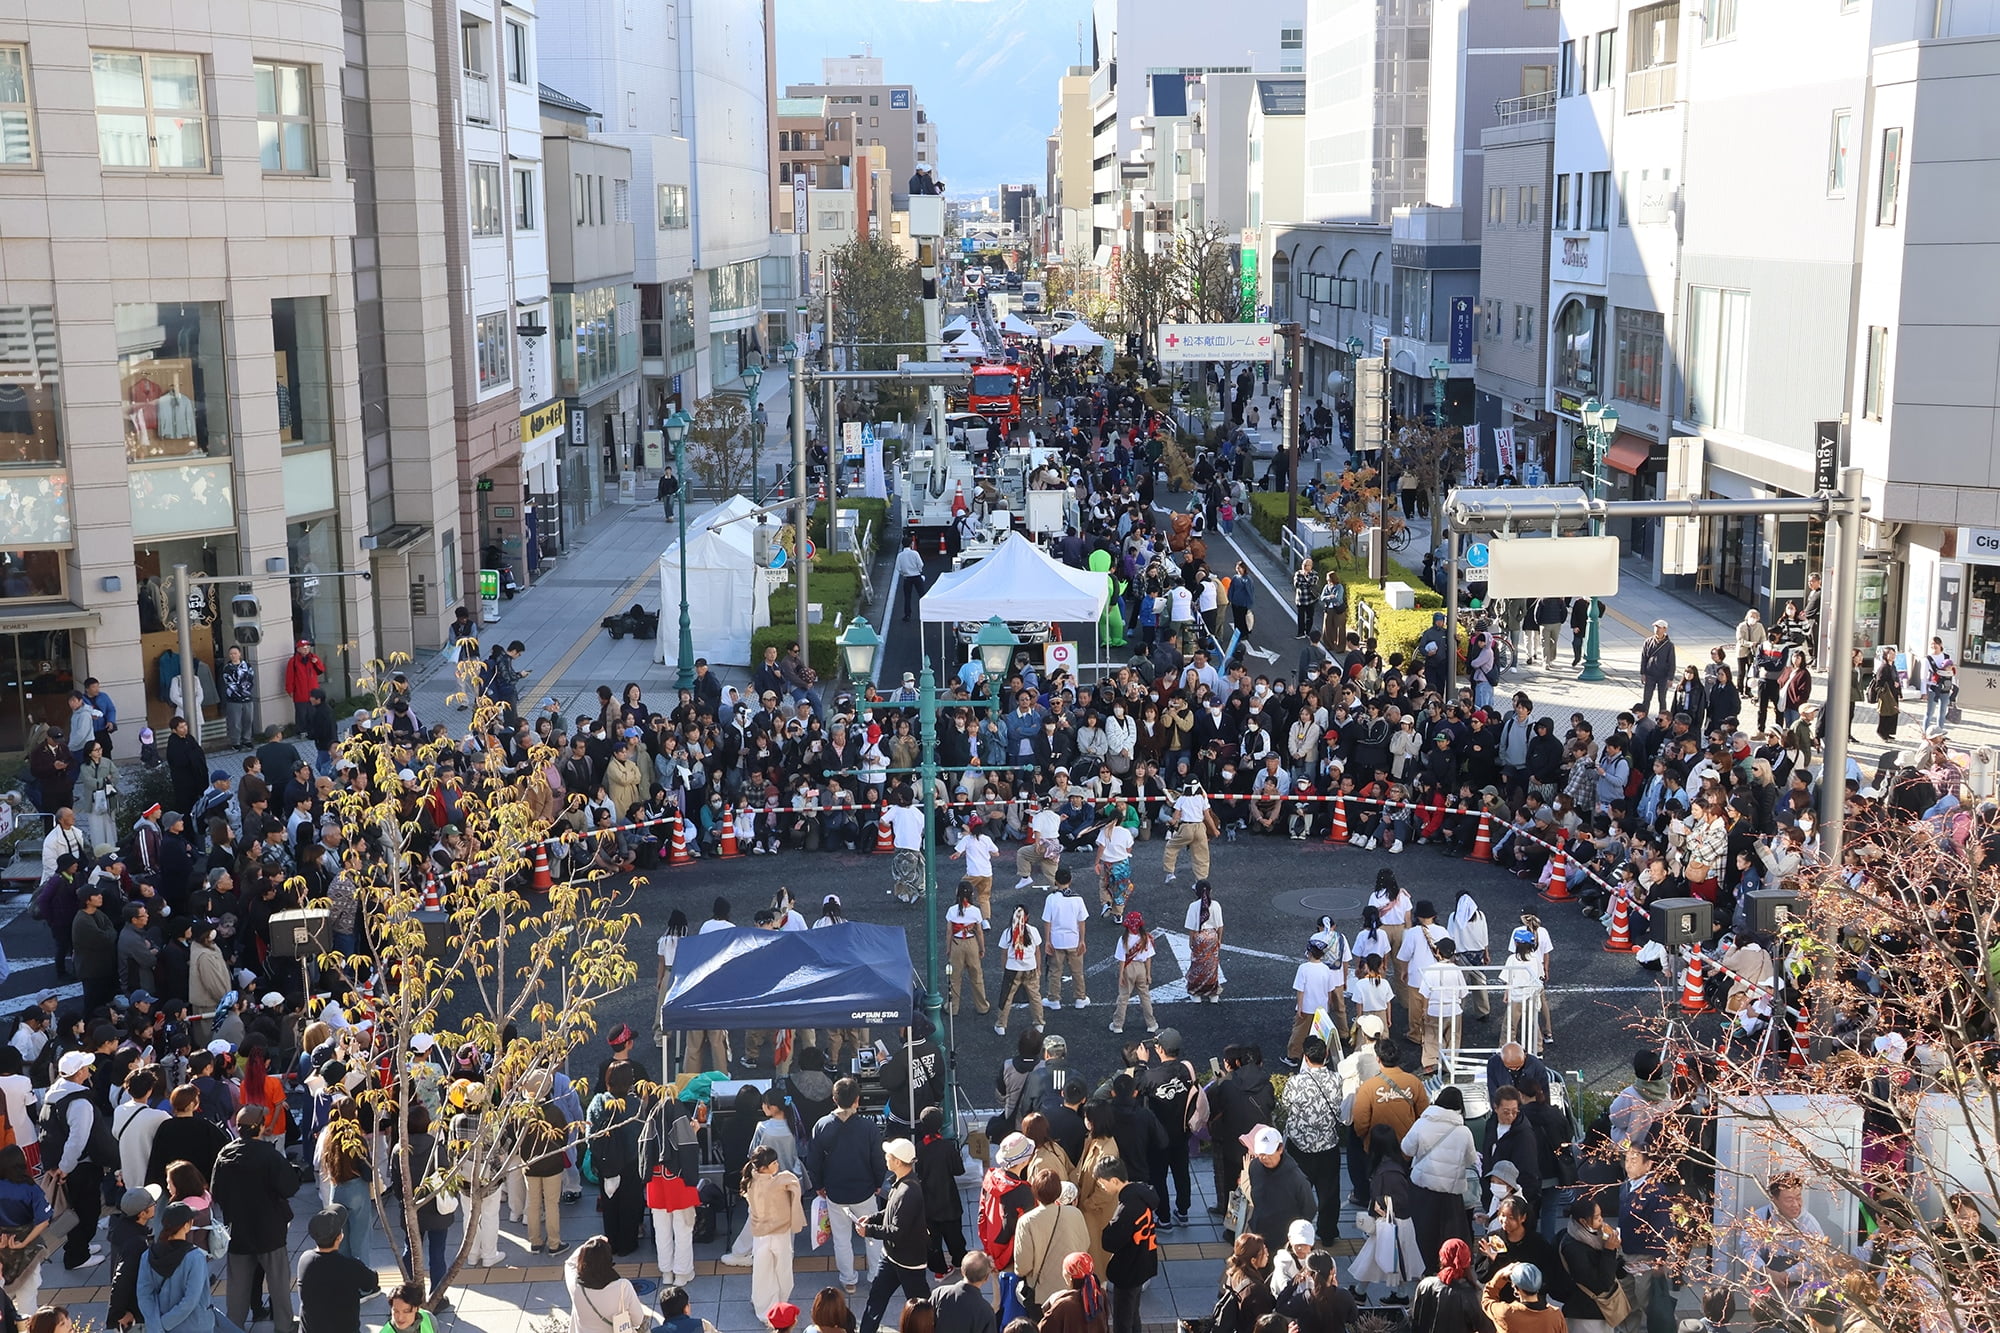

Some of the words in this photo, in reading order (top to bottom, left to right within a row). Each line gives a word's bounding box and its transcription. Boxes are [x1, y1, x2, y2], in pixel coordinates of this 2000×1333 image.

[1183, 336, 1254, 347] 松本献血ルーム
